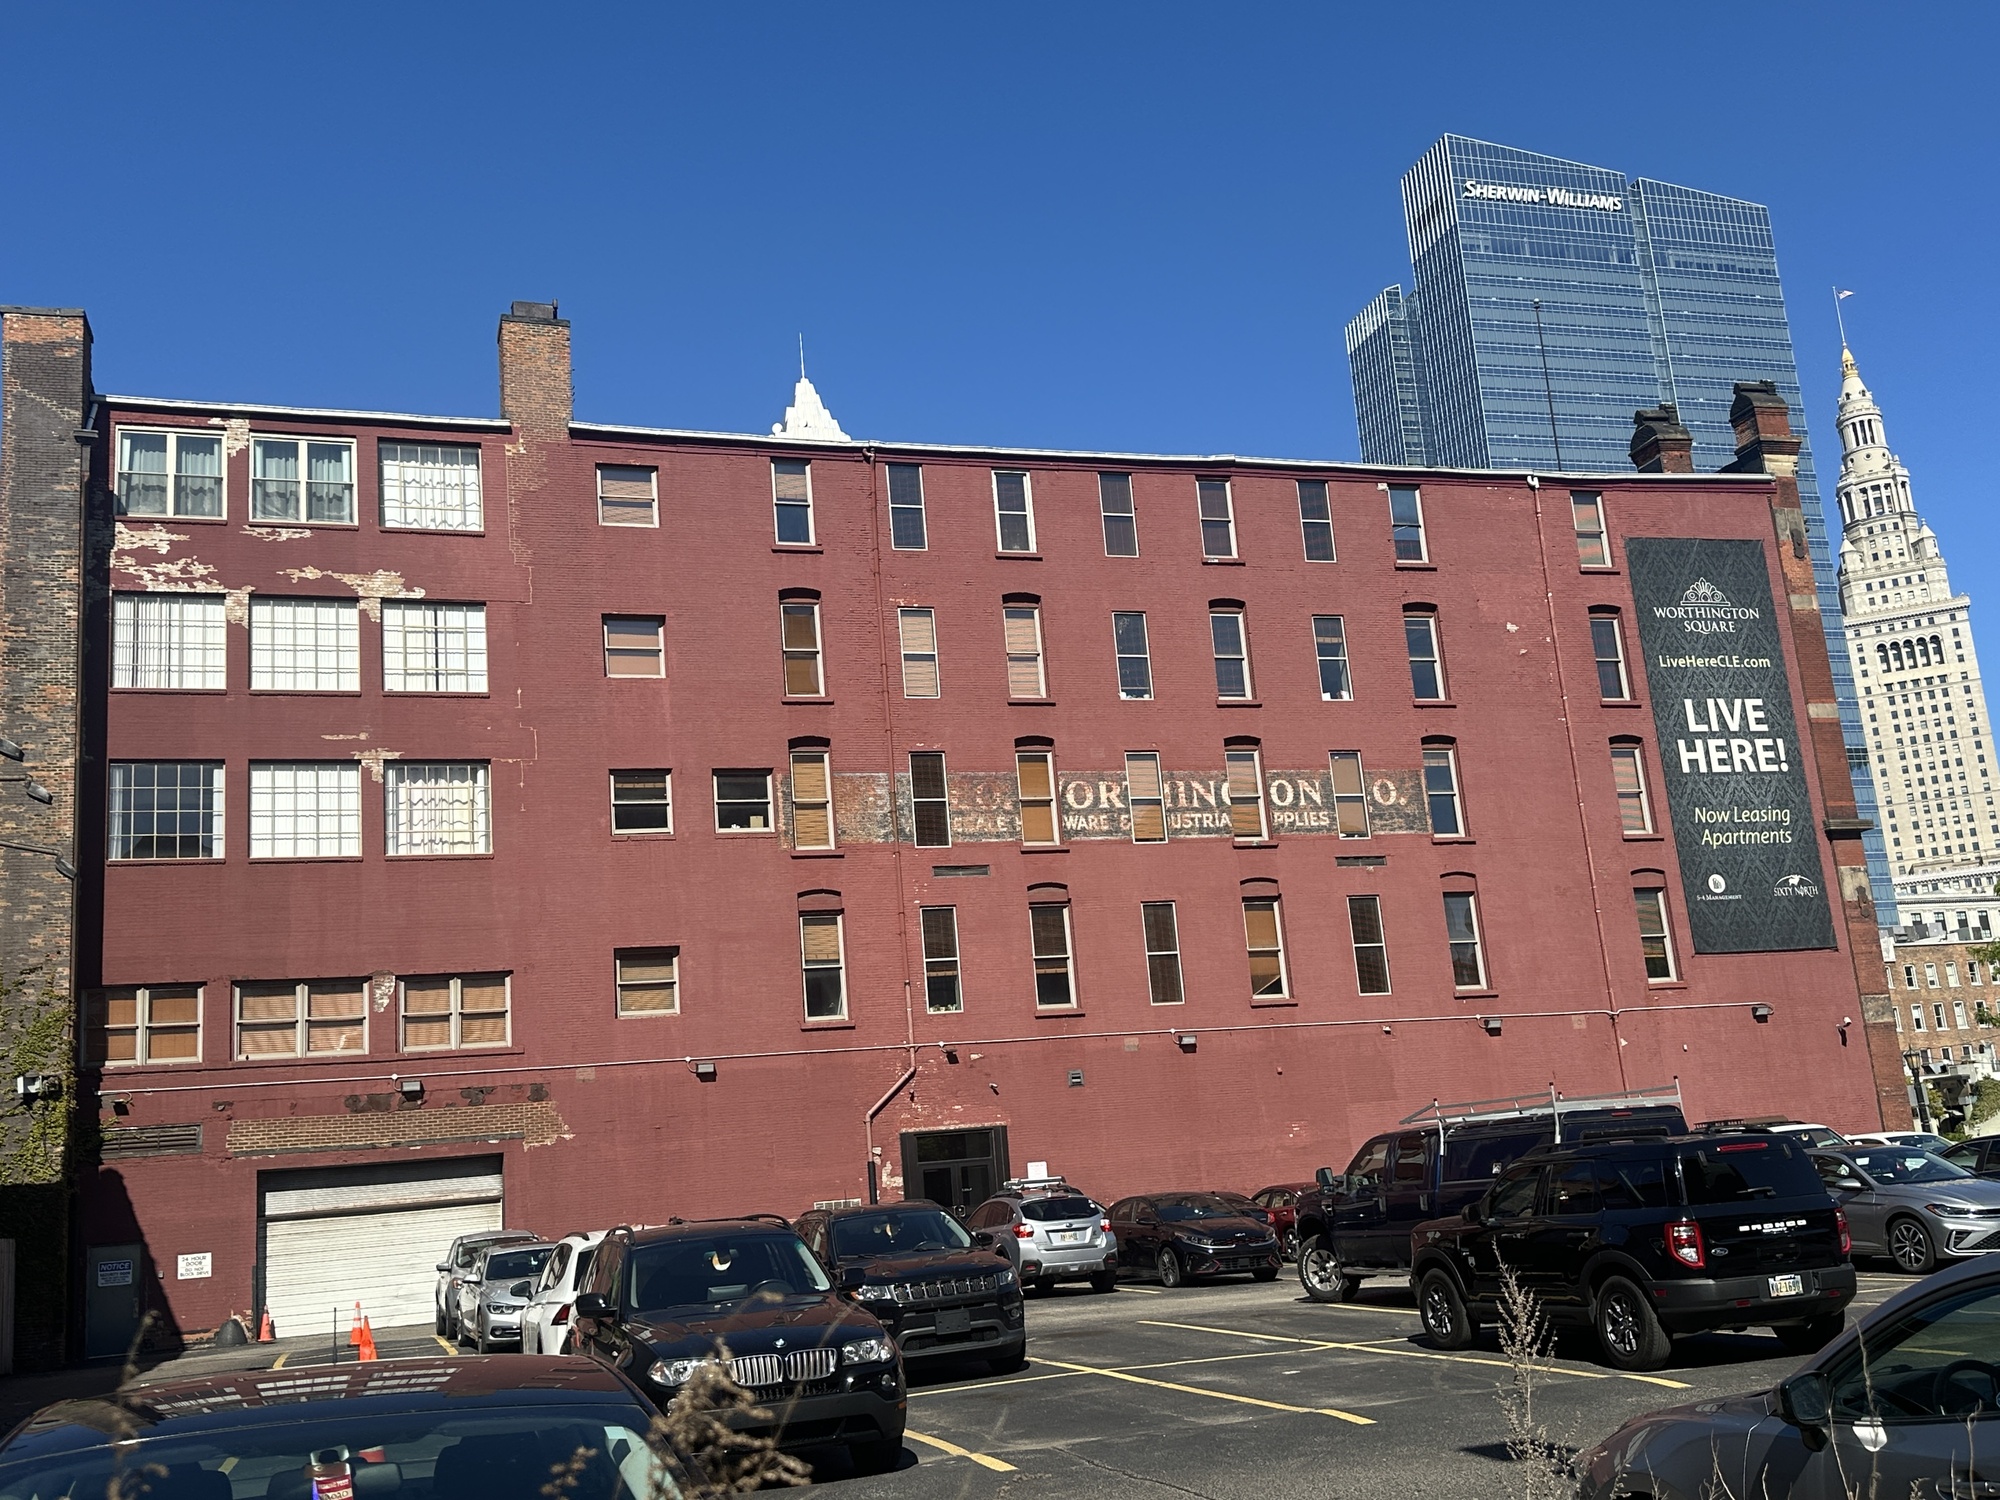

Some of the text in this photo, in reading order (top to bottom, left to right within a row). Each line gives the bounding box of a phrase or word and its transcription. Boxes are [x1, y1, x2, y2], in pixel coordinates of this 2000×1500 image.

[1653, 606, 1760, 620] WORTHINGTON
[1684, 620, 1736, 635] SQUARE
[1658, 655, 1771, 668] LiveHereCLE.com
[1683, 698, 1769, 732] LIVE
[1677, 738, 1789, 773] HERE!
[1695, 805, 1790, 826] Now Leasing
[1701, 829, 1792, 849] Apartments
[1739, 1219, 1807, 1232] BRONCO
[100, 1262, 130, 1271] NOTICE
